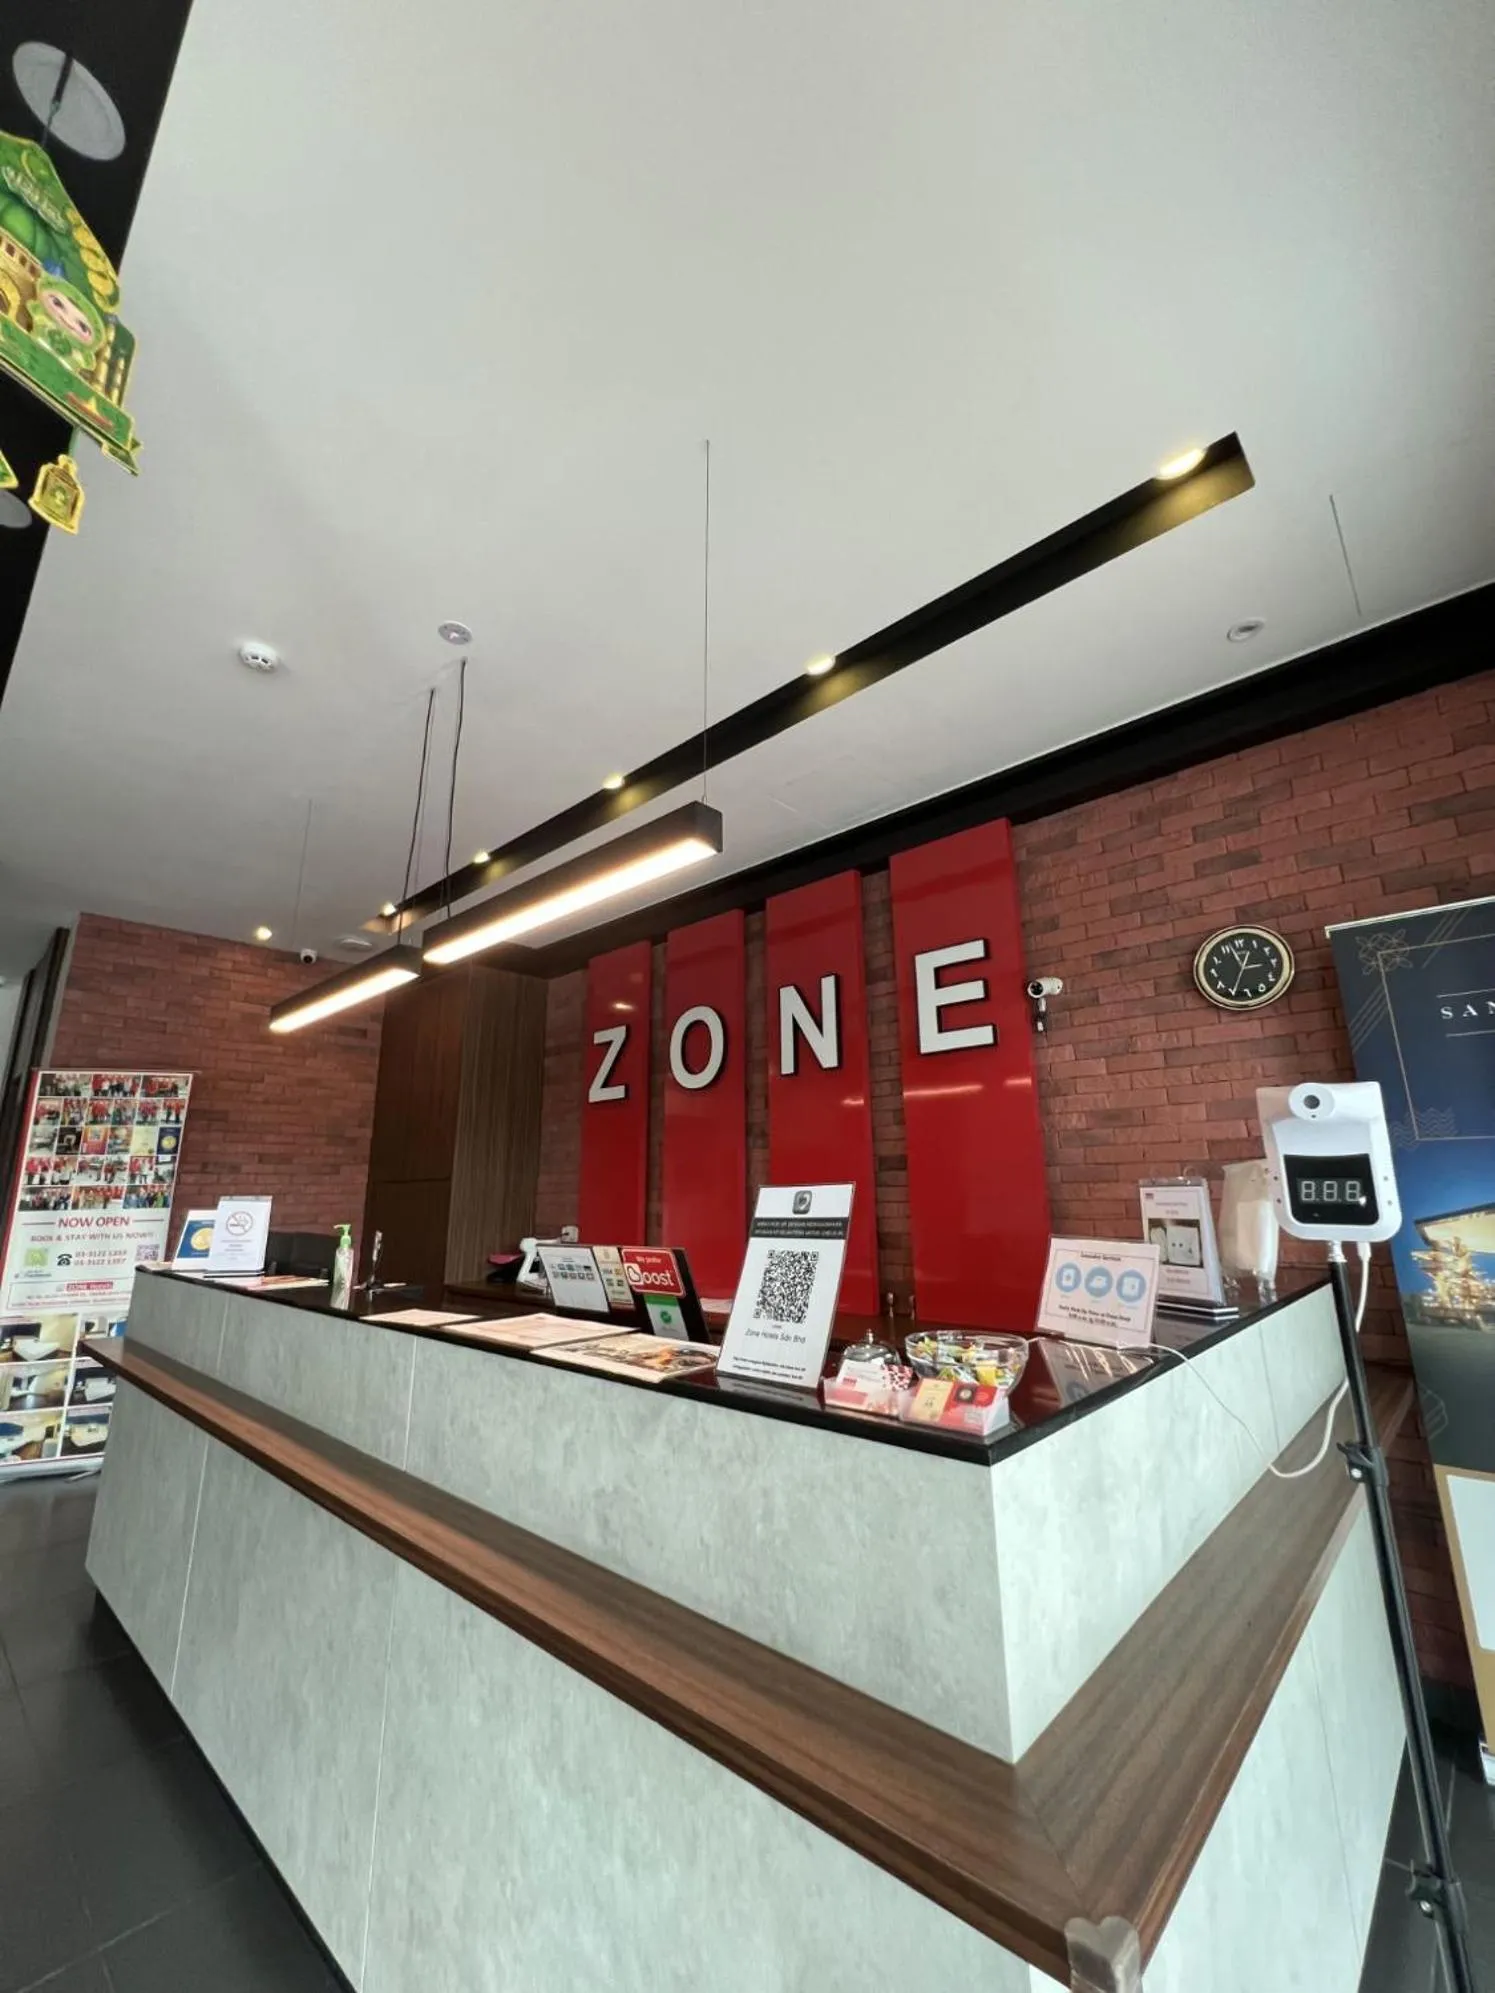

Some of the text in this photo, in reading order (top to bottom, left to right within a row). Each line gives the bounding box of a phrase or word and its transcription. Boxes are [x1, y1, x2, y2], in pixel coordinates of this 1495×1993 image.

[588, 938, 996, 1104] ZONE
[58, 1216, 130, 1229] NOW OPEN
